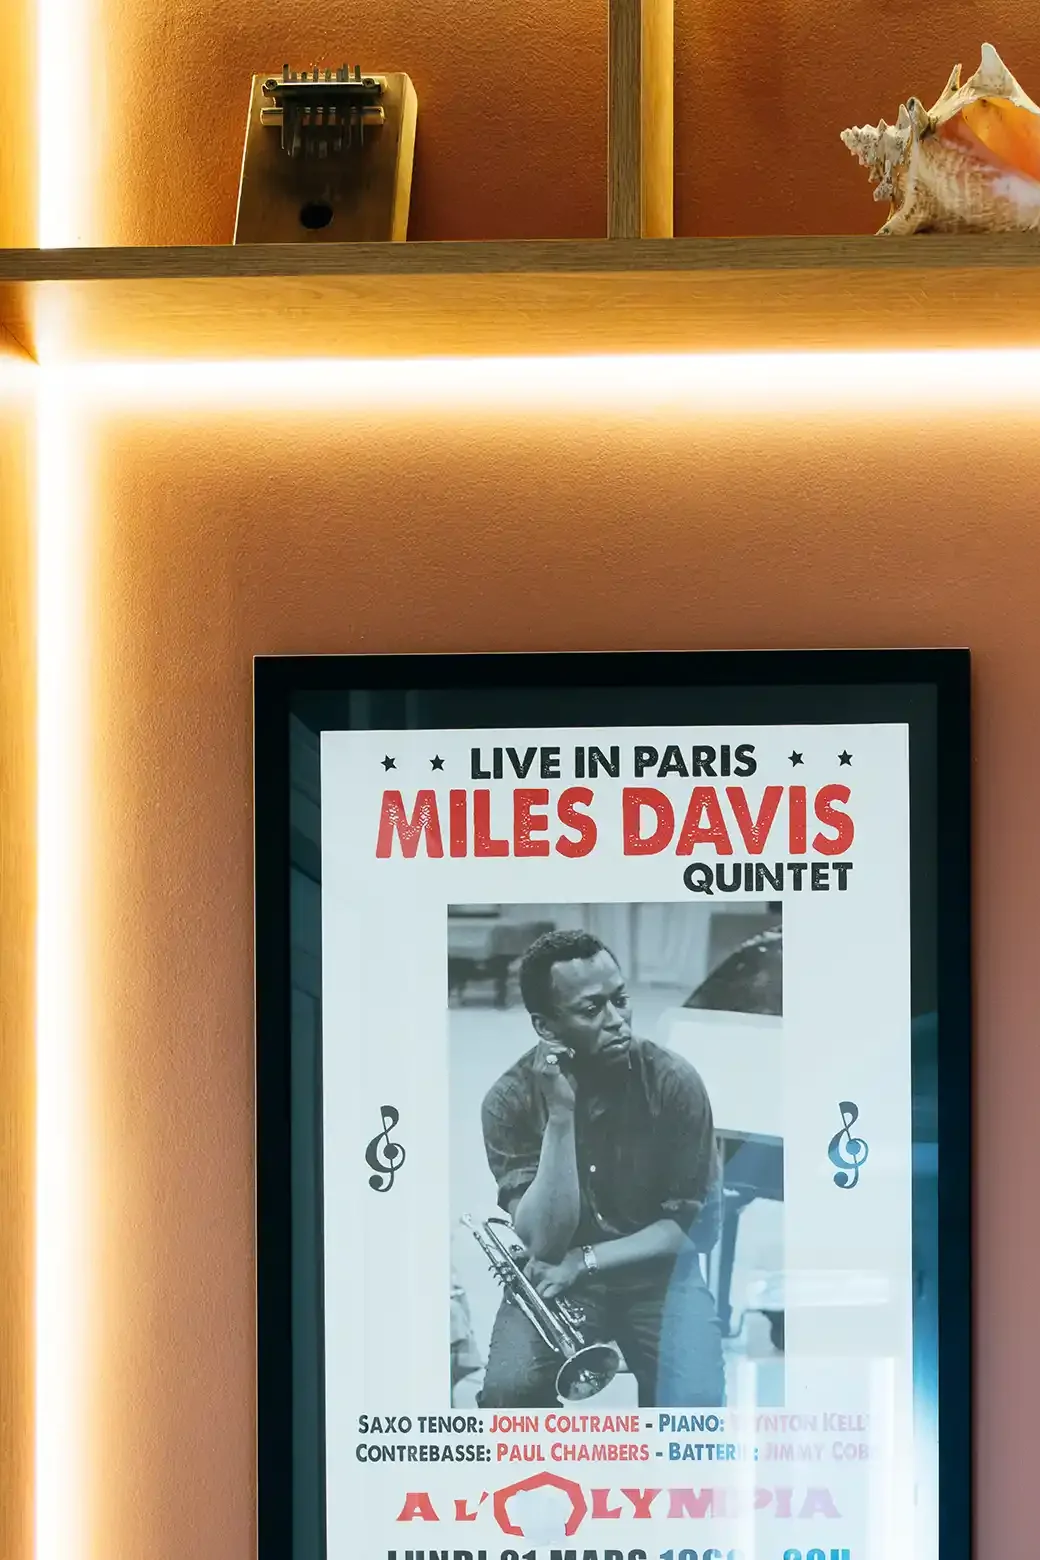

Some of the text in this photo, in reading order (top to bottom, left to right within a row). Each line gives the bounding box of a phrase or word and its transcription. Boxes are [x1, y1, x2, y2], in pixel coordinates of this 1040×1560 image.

[470, 744, 758, 780] LIVE IN PARIS
[375, 783, 855, 859] MILES DAVIS
[682, 861, 854, 896] QUINTET
[358, 1414, 413, 1434] SAXO
[417, 1415, 484, 1434] TENOR:
[489, 1414, 539, 1433] JOHN
[544, 1413, 640, 1433] COLTRANE
[658, 1413, 725, 1432] PIANO:
[730, 1413, 817, 1432] YNTON
[822, 1412, 871, 1432] KELL
[356, 1443, 491, 1463] CONTREBASSE:
[496, 1443, 545, 1462] PAUL
[550, 1442, 649, 1462] CHAMBERS
[832, 1440, 876, 1460] COB
[396, 1492, 440, 1521] A
